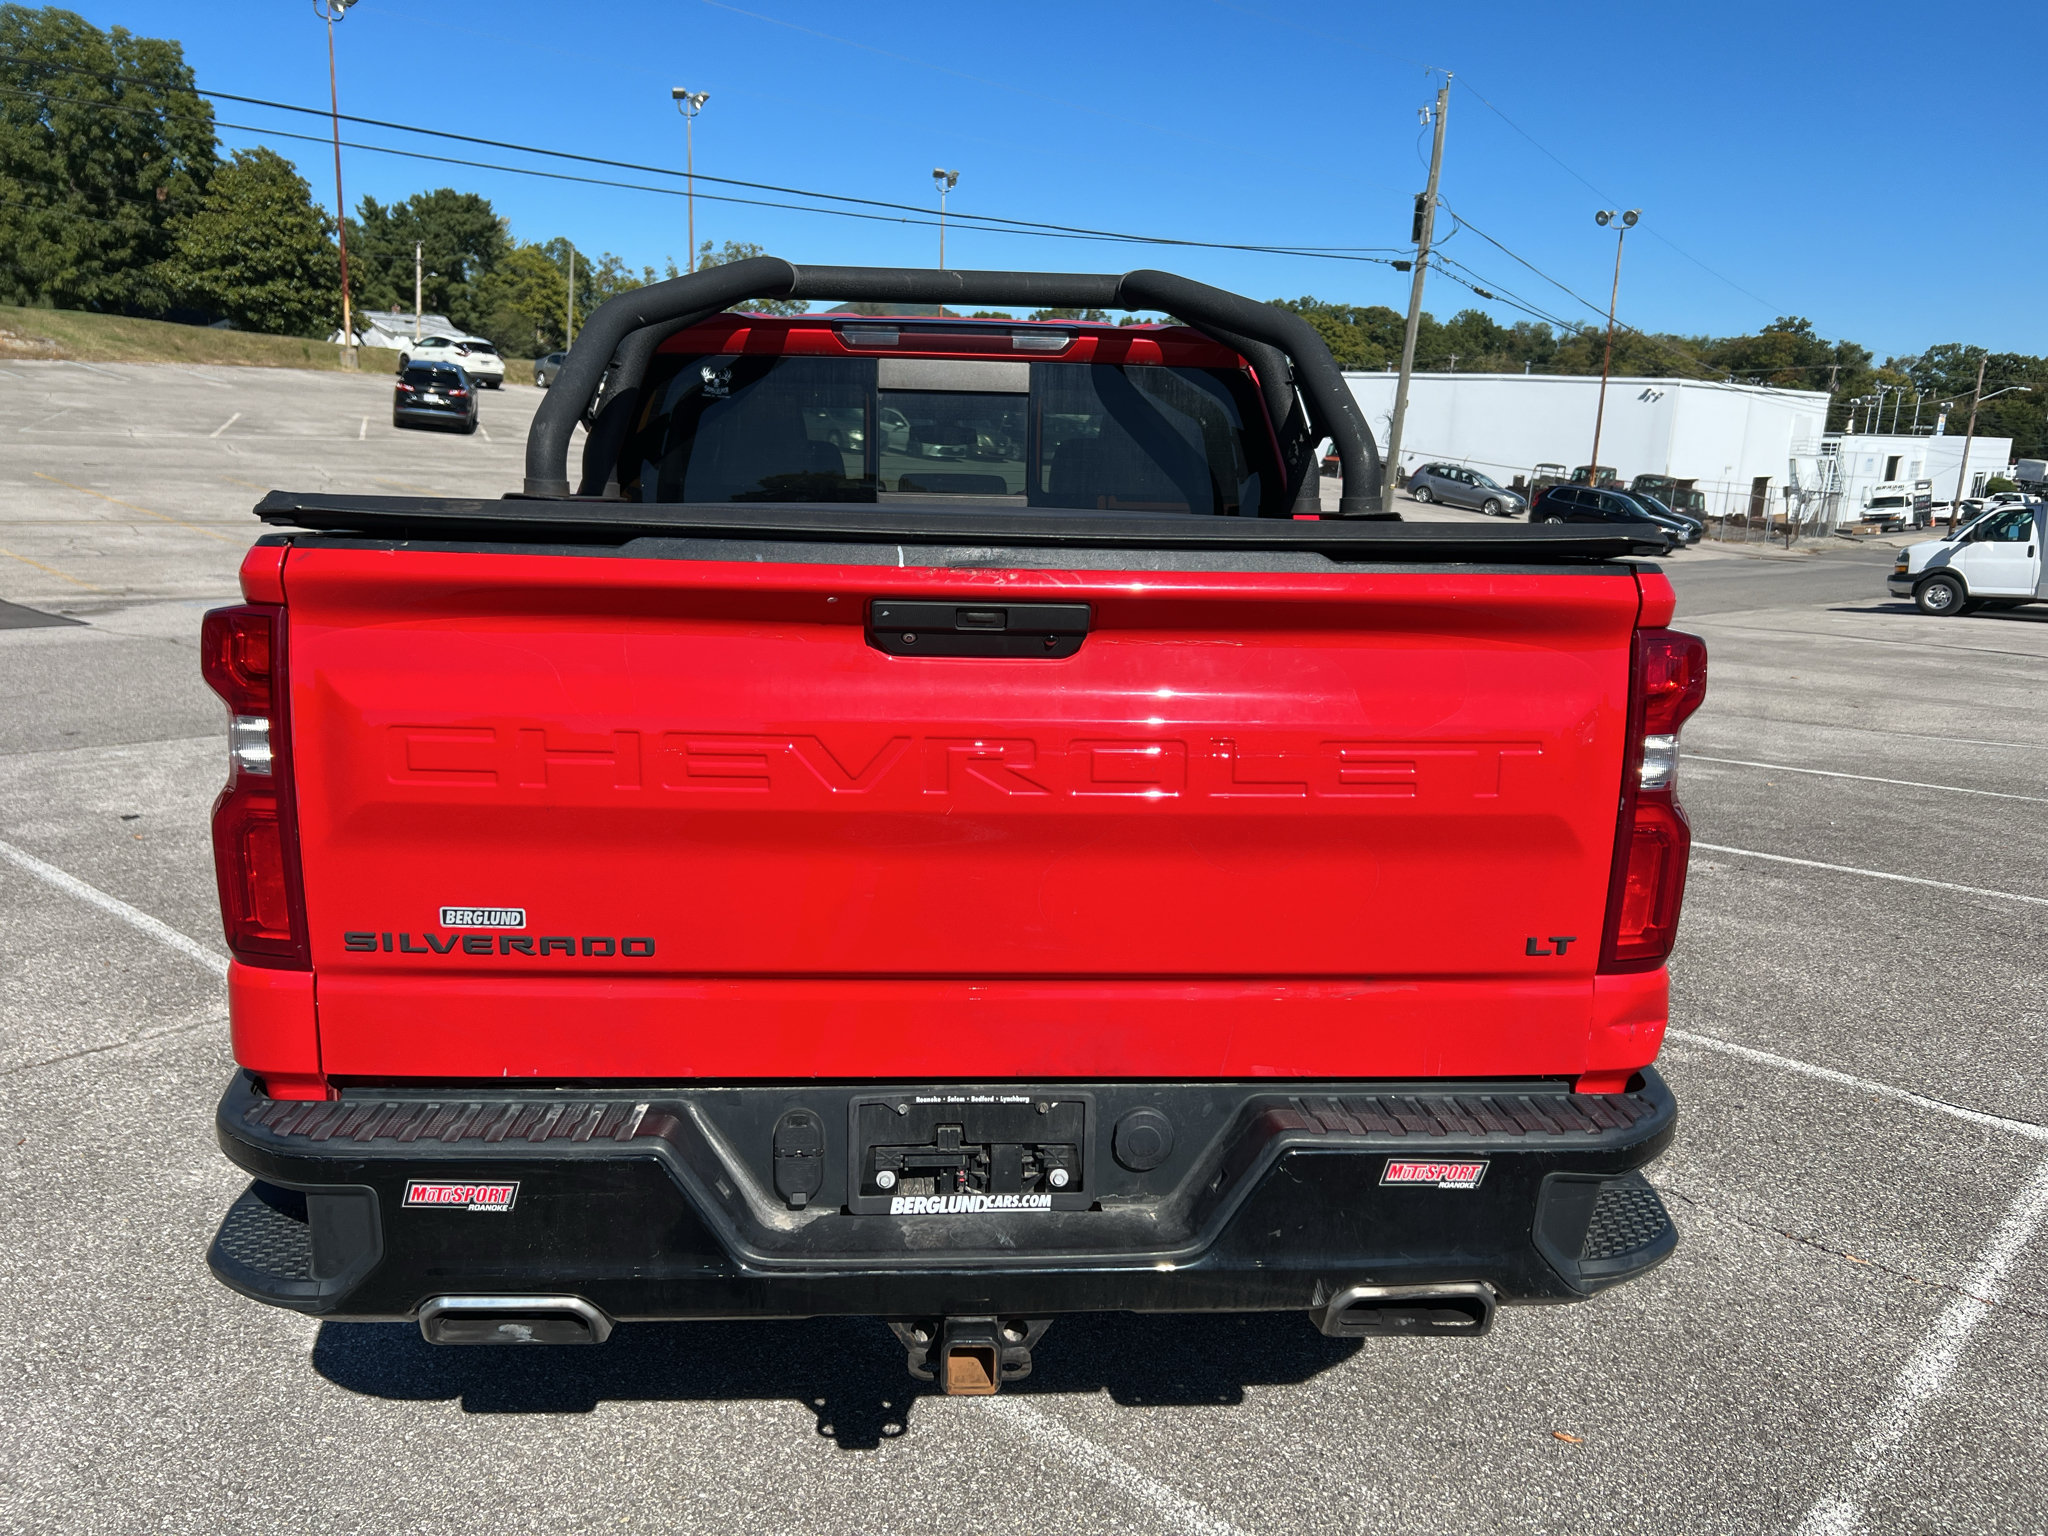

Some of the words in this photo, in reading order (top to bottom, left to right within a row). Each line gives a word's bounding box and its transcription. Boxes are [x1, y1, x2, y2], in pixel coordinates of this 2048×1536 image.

[386, 725, 1543, 798] CHEVROLET
[444, 909, 522, 927] BERGLUND
[344, 931, 656, 957] SILVERADO
[1526, 936, 1577, 956] LT
[1438, 1181, 1476, 1189] ROANOKE
[467, 1203, 509, 1212] ROANOKE
[889, 1194, 1052, 1215] BERGLUNDCARS.COM
